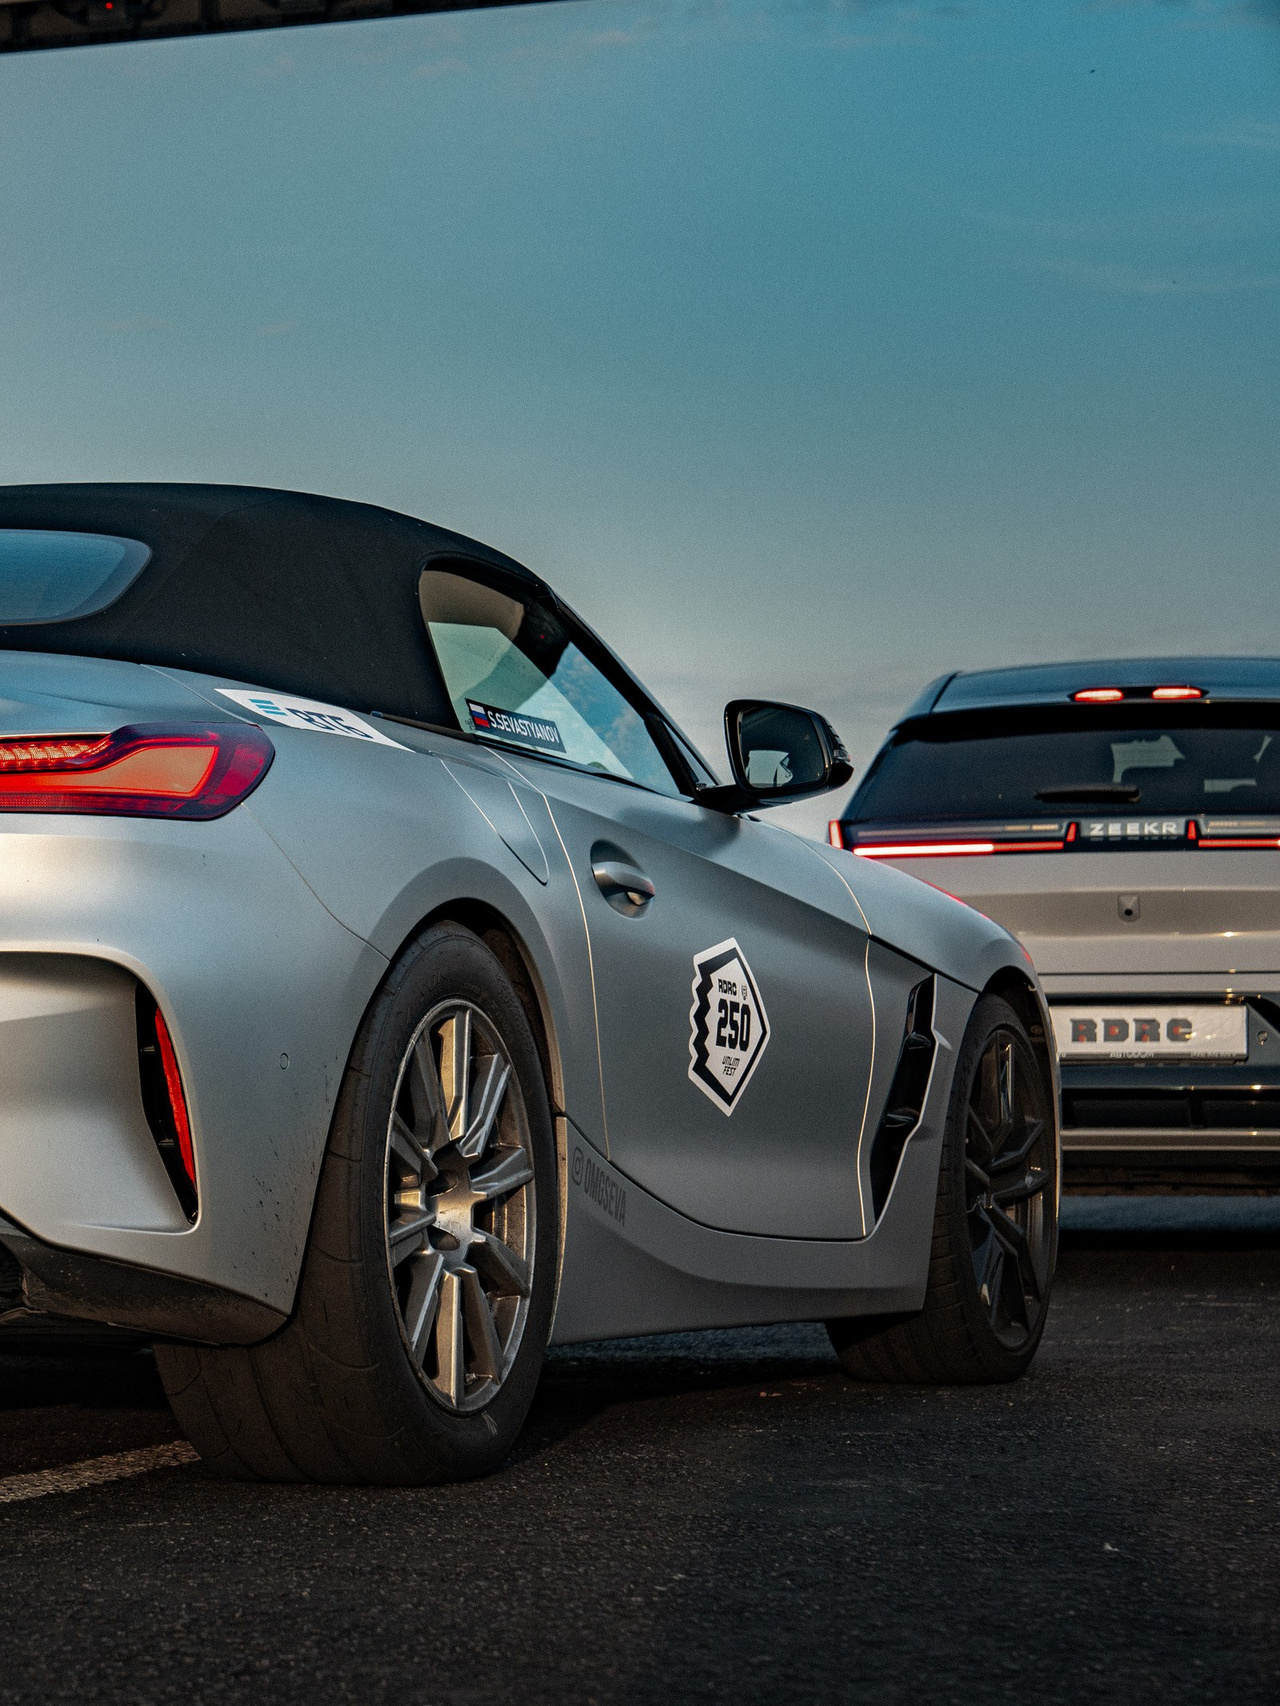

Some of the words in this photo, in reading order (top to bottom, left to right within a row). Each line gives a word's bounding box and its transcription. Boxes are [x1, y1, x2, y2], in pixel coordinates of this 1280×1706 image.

[1089, 821, 1177, 836] ZEEKR
[718, 978, 737, 996] RDRC
[716, 998, 751, 1052] 250
[1070, 1018, 1193, 1042] RDRC
[722, 1066, 736, 1077] FEST
